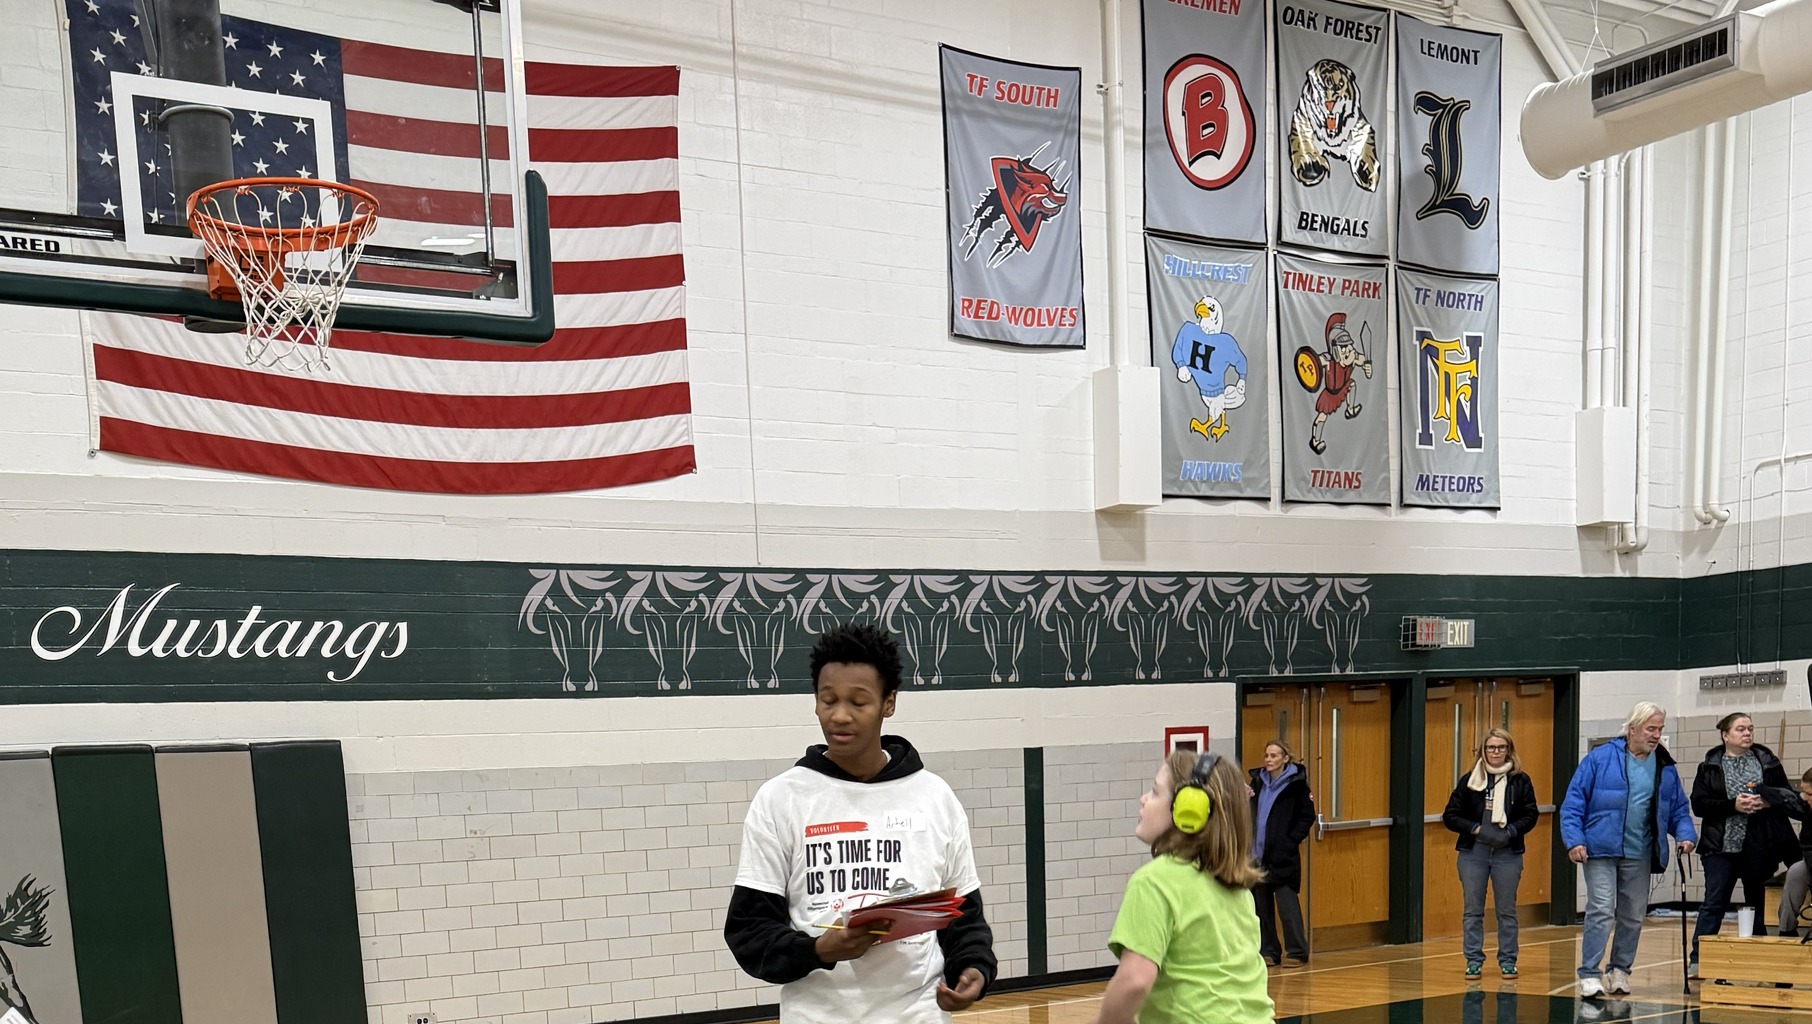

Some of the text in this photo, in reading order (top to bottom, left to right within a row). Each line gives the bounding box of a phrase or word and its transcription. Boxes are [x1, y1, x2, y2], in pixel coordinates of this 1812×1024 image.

[1282, 6, 1382, 44] OAK FOREST
[1420, 38, 1480, 65] LEMONT
[966, 73, 1060, 108] TF SOUTH
[1182, 72, 1229, 168] B
[1413, 91, 1490, 230] L
[1297, 211, 1369, 239] BENGALS
[1164, 254, 1253, 284] HILLCREST
[1282, 271, 1382, 300] TINLEY PARK
[1414, 287, 1484, 311] TF NORTH
[1189, 340, 1216, 374] H
[1180, 460, 1243, 483] HAWKS
[1311, 469, 1362, 489] TITANS
[1415, 474, 1484, 493] METEORS
[30, 582, 409, 683] Mustangs
[1447, 621, 1469, 645] EXIT
[837, 839, 872, 864] TIME
[877, 839, 902, 863] FOR
[806, 867, 889, 895] US TO COME
